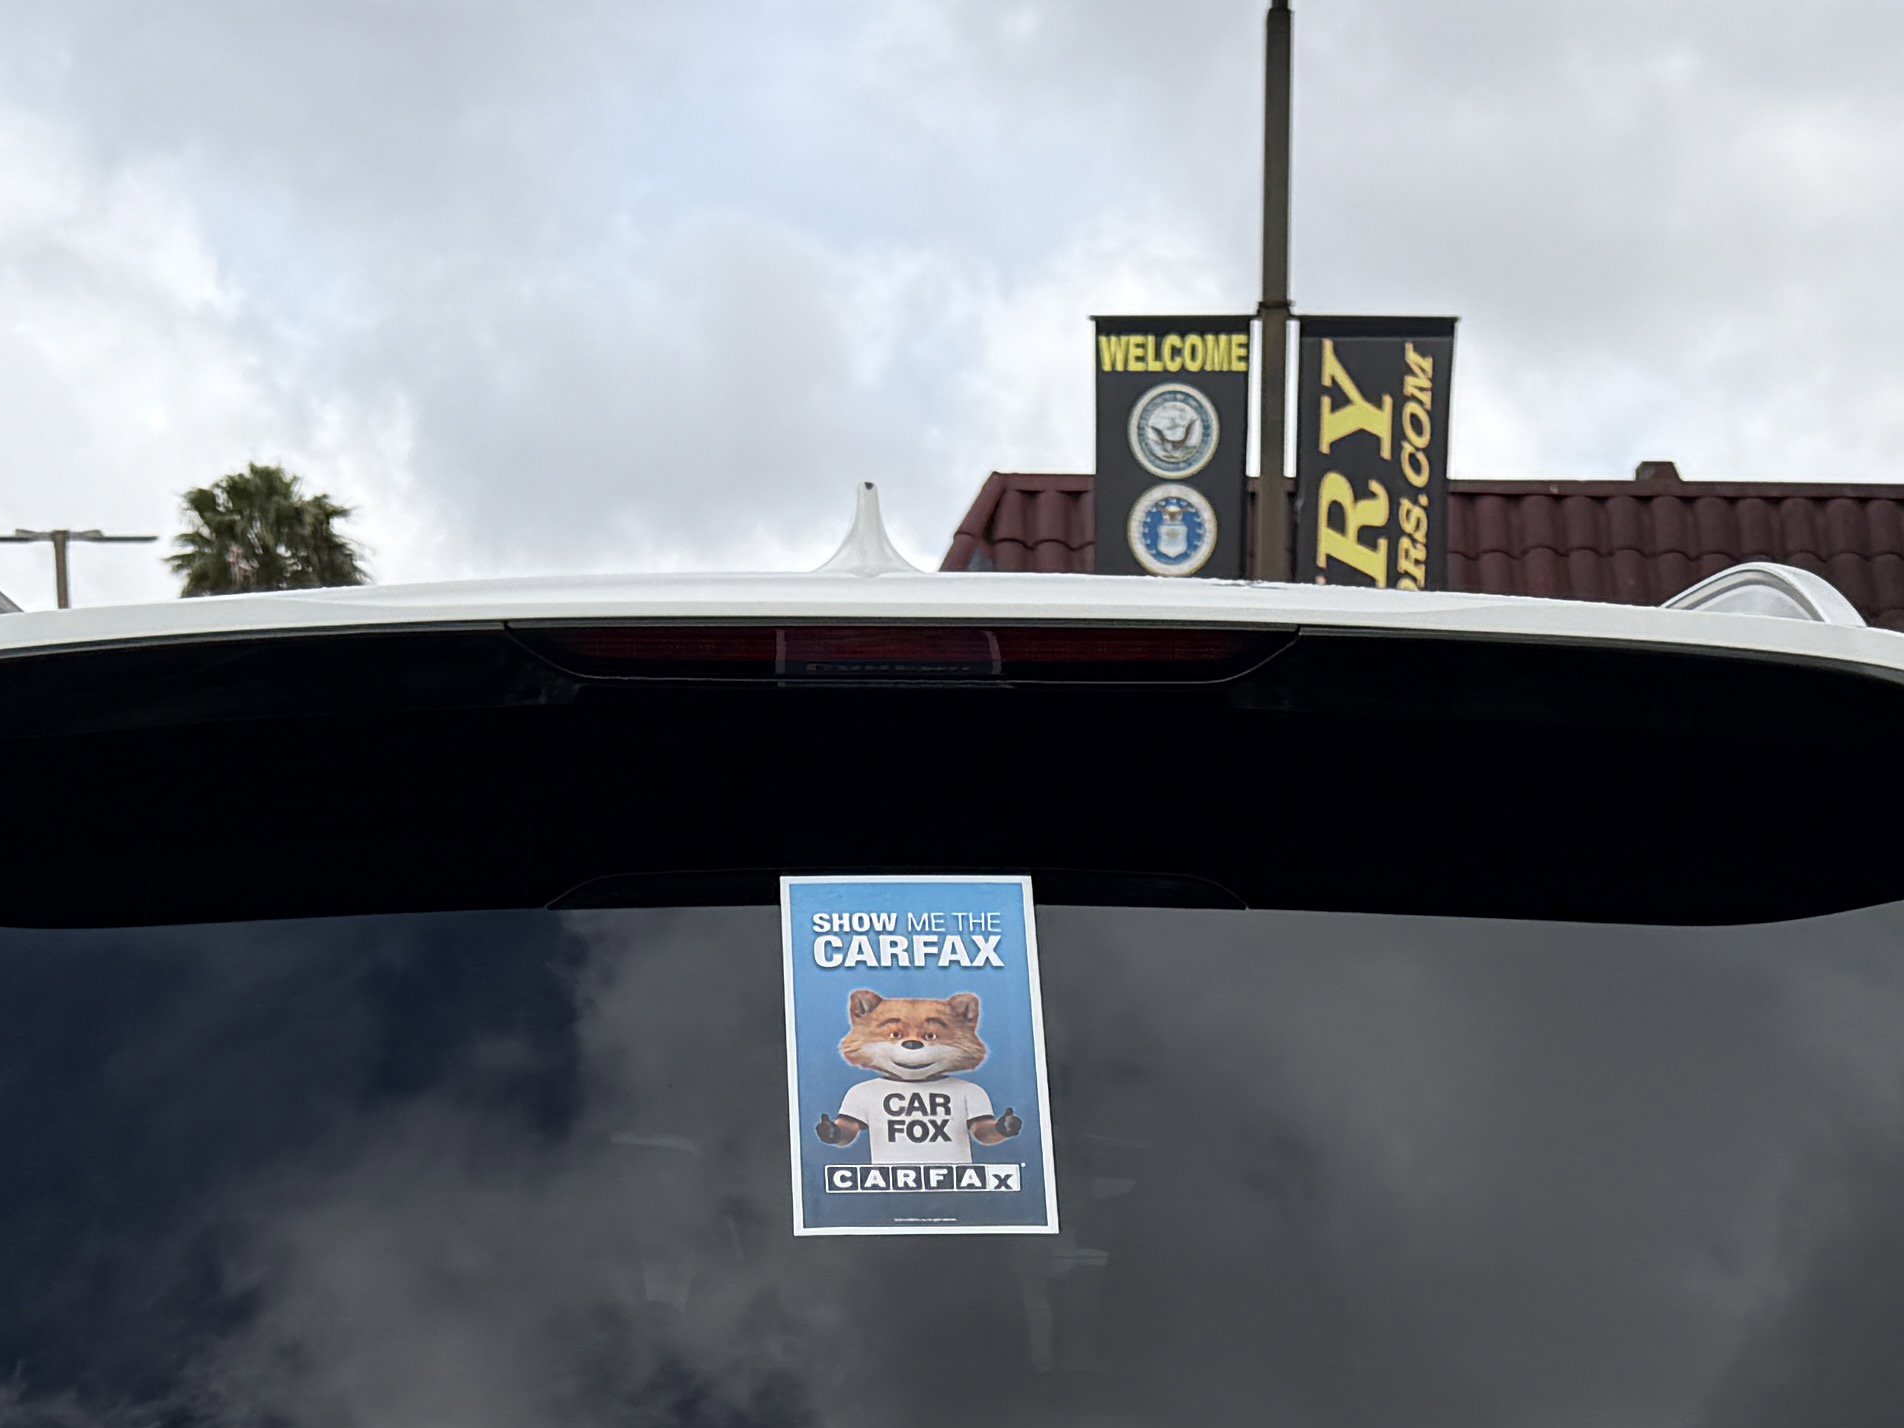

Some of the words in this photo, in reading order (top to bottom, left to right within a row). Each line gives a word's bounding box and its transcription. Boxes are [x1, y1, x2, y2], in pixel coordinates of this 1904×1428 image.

[1098, 333, 1249, 372] WELCOME
[812, 912, 897, 932] SHOW
[907, 912, 945, 931] ME
[952, 912, 1001, 932] THE
[813, 934, 1005, 968] CARFAX
[883, 1092, 952, 1117] CAR
[887, 1119, 953, 1143] FOX
[832, 1169, 1014, 1190] CARFAX
